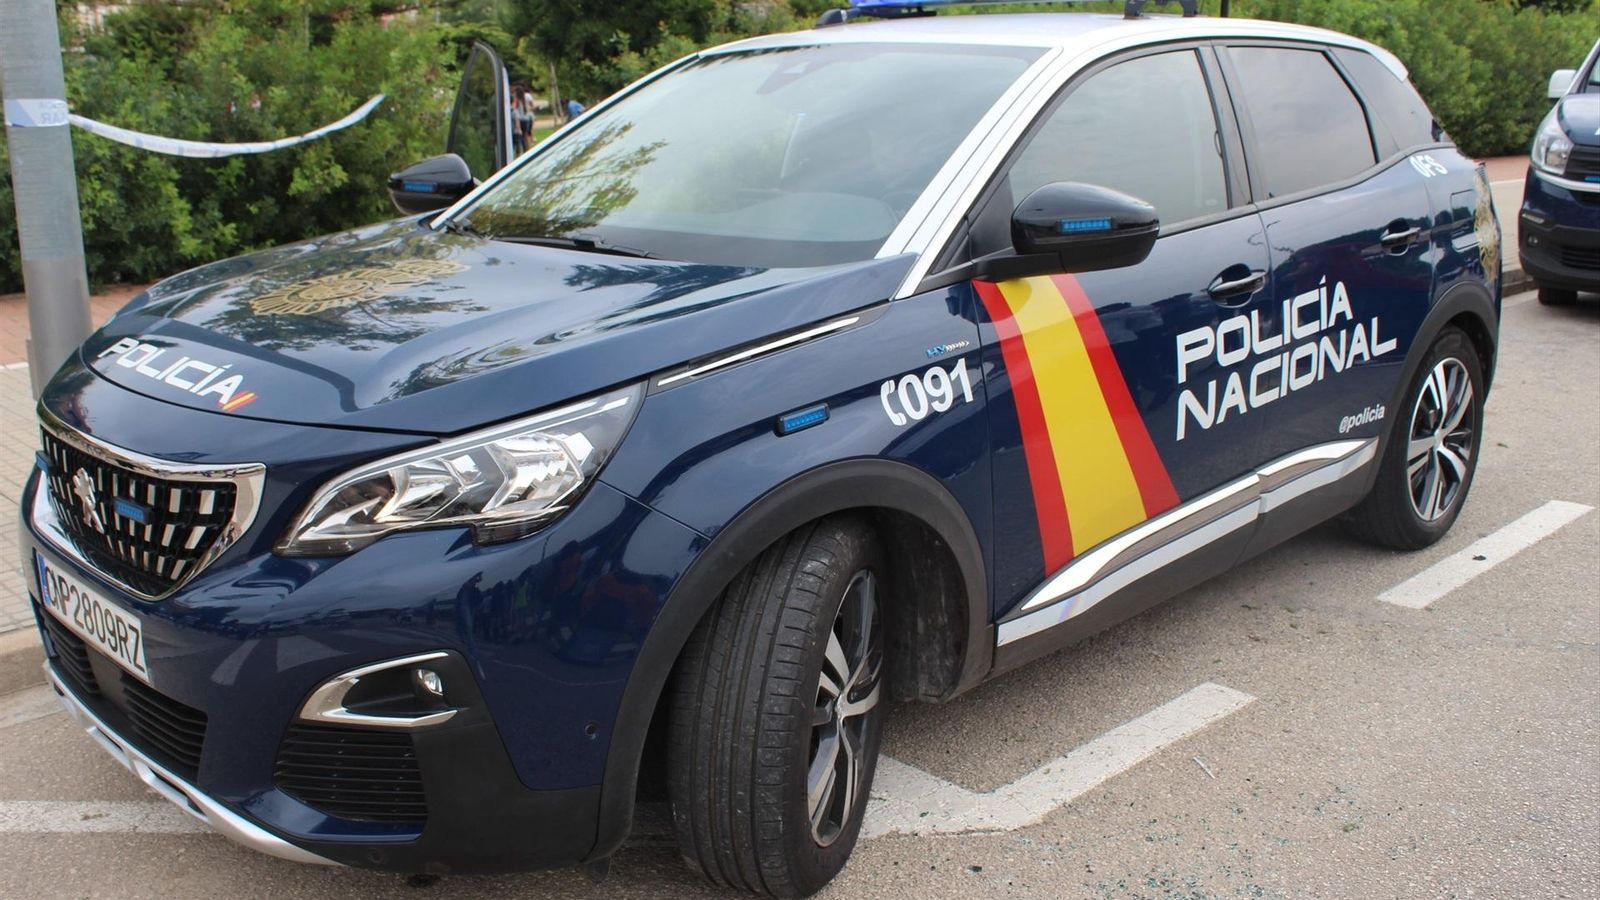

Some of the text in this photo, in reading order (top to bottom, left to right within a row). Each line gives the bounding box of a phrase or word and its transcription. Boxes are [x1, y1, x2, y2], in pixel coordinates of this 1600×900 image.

[1176, 274, 1353, 384] POLICÍA
[97, 337, 243, 405] POLICÍA
[896, 357, 974, 420] 091
[1176, 316, 1397, 441] NACIONAL
[1338, 403, 1385, 433] @policia
